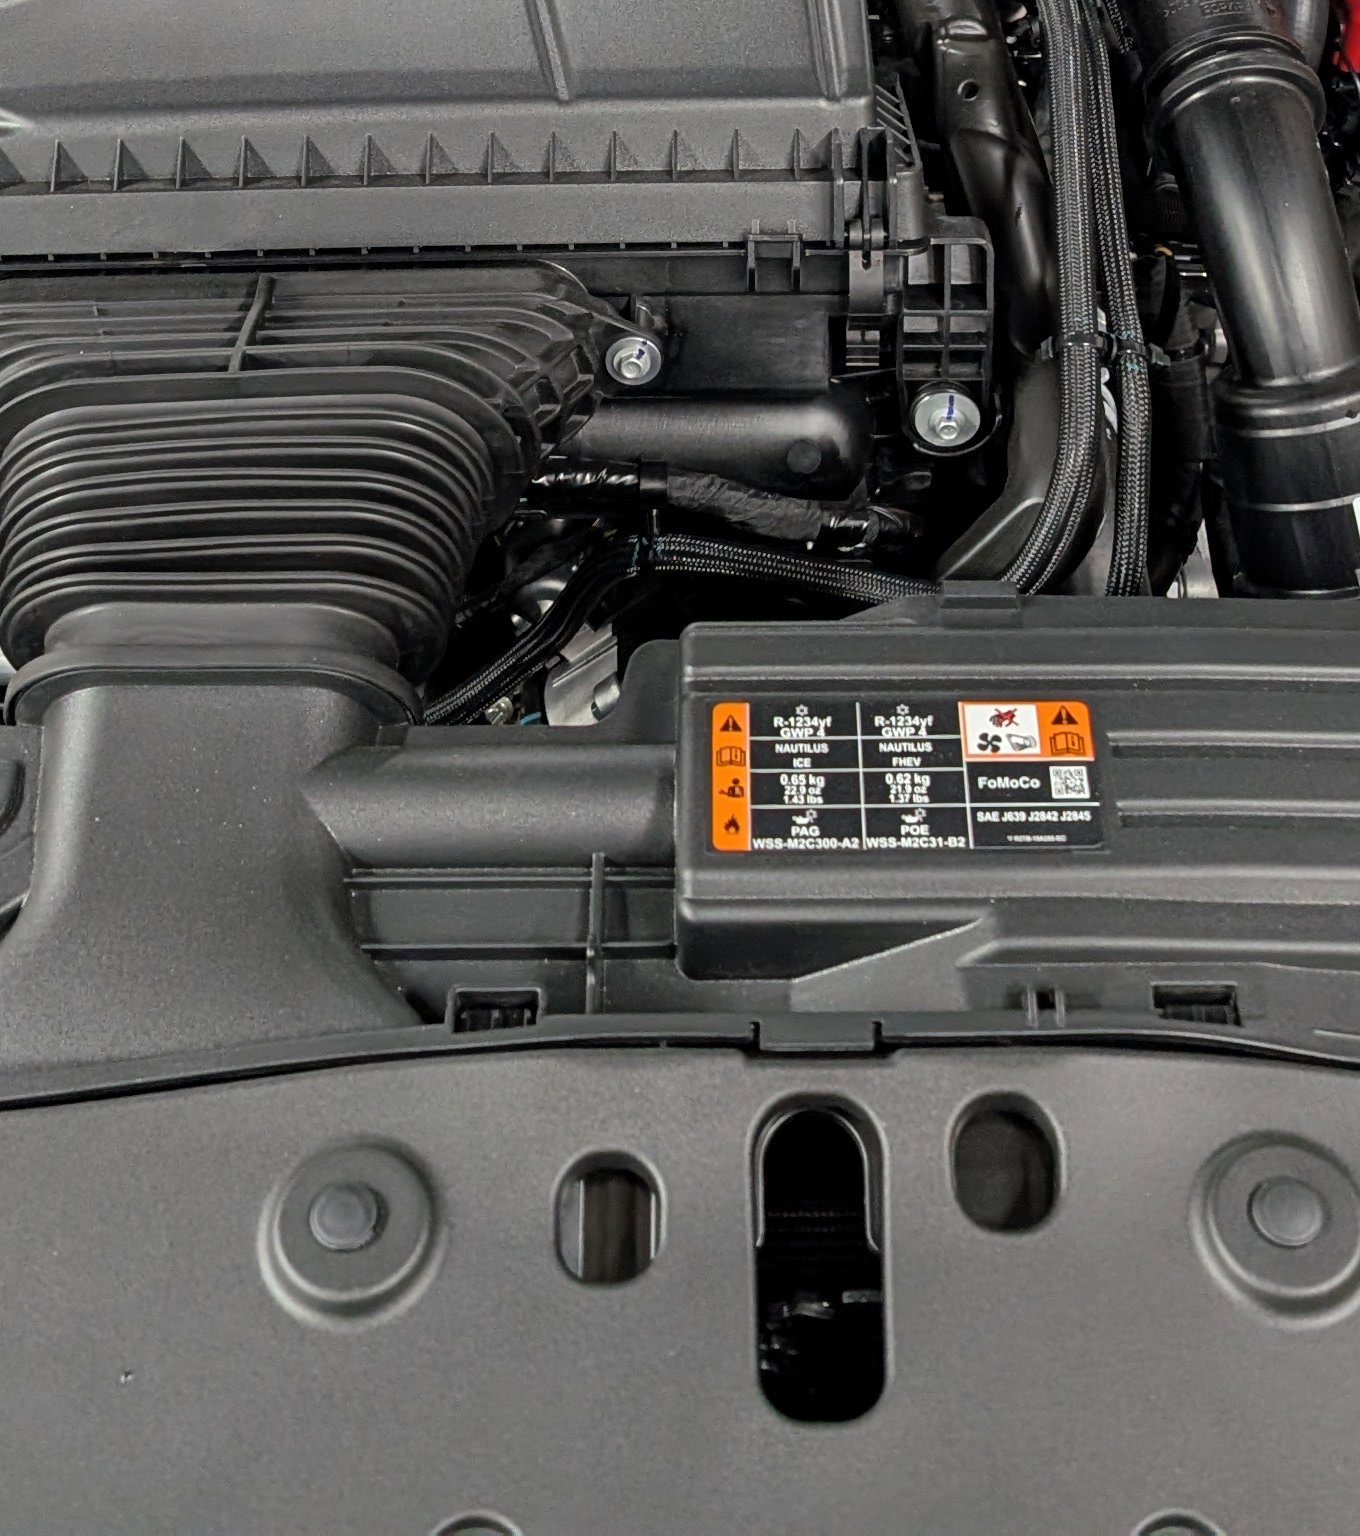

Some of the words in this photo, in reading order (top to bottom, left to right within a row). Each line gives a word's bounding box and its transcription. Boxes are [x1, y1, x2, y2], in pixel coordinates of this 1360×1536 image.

[773, 716, 832, 729] R-1234yf
[874, 715, 934, 728] R-1234yf
[780, 728, 814, 738] GWP
[817, 728, 825, 738] 4
[881, 727, 915, 737] GWP
[918, 727, 927, 737] 4
[775, 743, 829, 753] NAUTILUS
[879, 742, 933, 752] NAUTILUS
[793, 758, 811, 768] ICE
[892, 757, 921, 767] FHEV
[780, 774, 807, 785] 0.65
[808, 774, 825, 787] kg
[885, 773, 912, 784] 0.62
[914, 773, 931, 787] kg
[978, 776, 1040, 790] FoMoCo
[784, 786, 807, 795] 22.9
[808, 786, 822, 795] oz
[890, 785, 912, 794] 21.9
[914, 785, 928, 794] oz
[783, 795, 805, 804] 1.43
[807, 795, 824, 804] lbs
[889, 794, 911, 803] 1.37
[913, 794, 930, 803] lbs
[976, 811, 1000, 822] SAE
[1001, 811, 1027, 822] J639
[1028, 810, 1059, 822] J2842
[1060, 810, 1092, 822] J2845
[791, 826, 820, 837] PAG
[901, 825, 929, 835] POE
[752, 838, 859, 849] WSS-M2C300-A2
[866, 837, 966, 848] WSS-M2C31-B2
